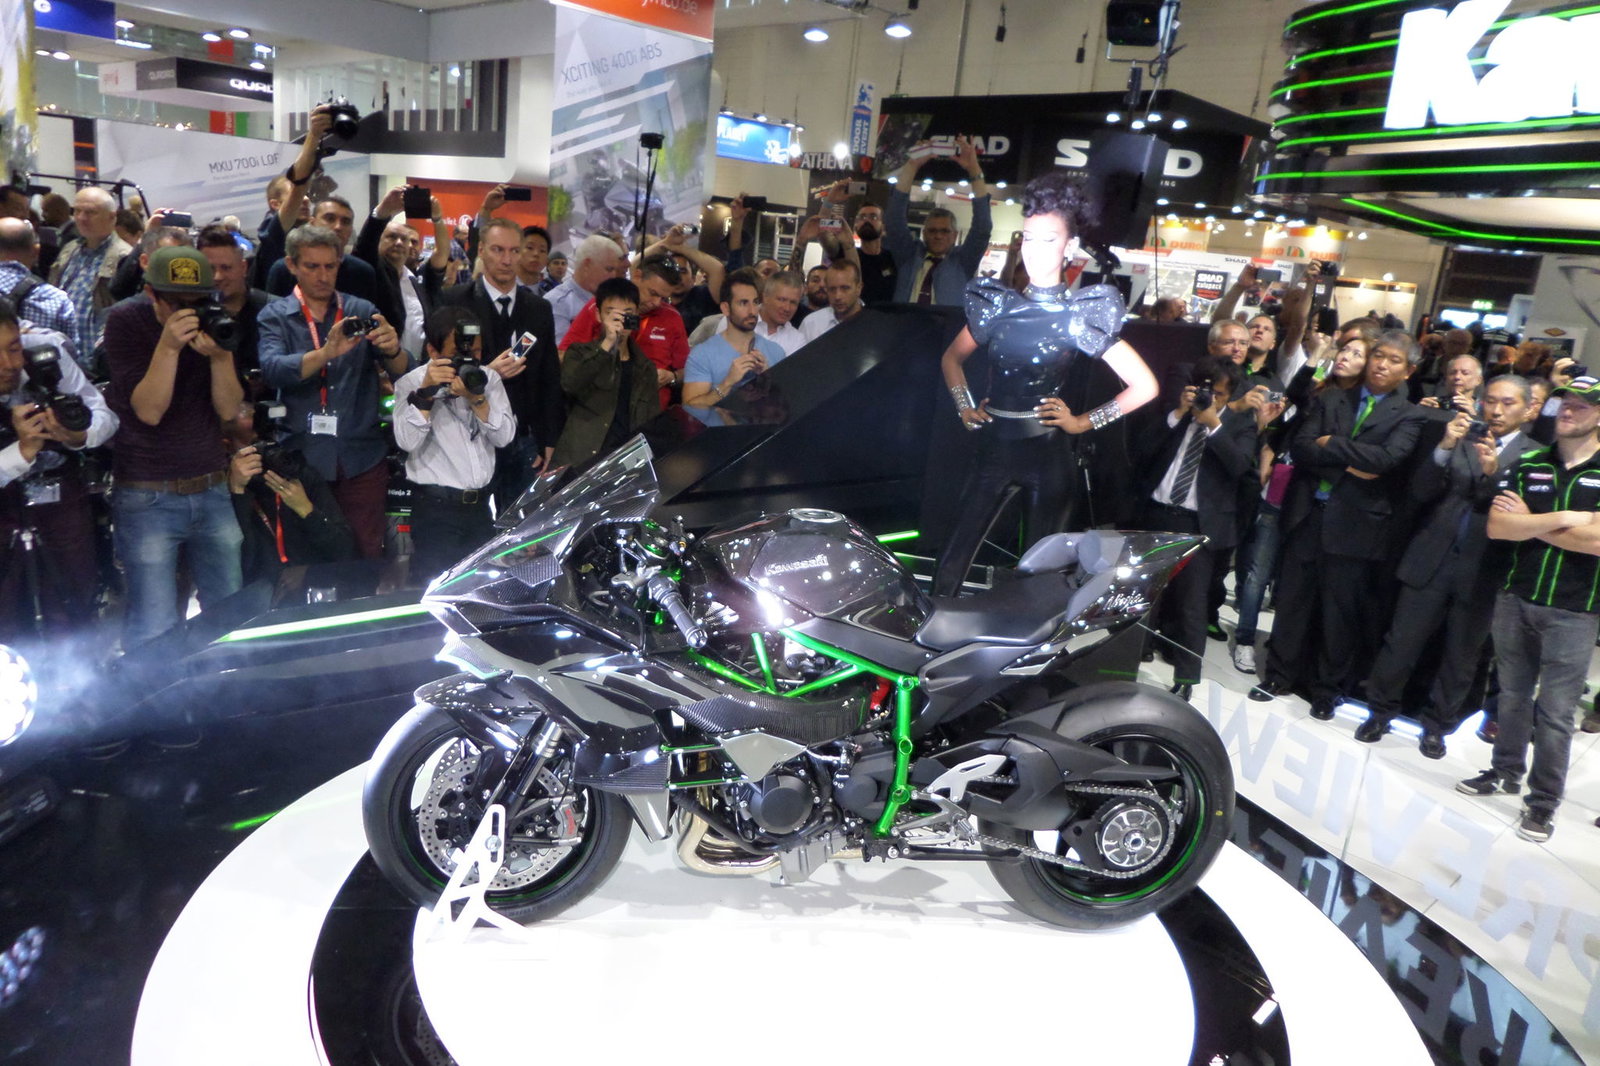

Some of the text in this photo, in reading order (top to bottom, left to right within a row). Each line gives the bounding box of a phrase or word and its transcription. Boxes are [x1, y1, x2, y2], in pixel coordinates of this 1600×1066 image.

[561, 42, 663, 85] XCITING 400i ABS
[209, 161, 233, 173] MXU
[234, 157, 259, 170] 700i
[1054, 138, 1203, 178] SD
[1198, 273, 1223, 283] SHAD
[764, 553, 829, 576] Kawasaki
[1103, 590, 1144, 611] Ninja
